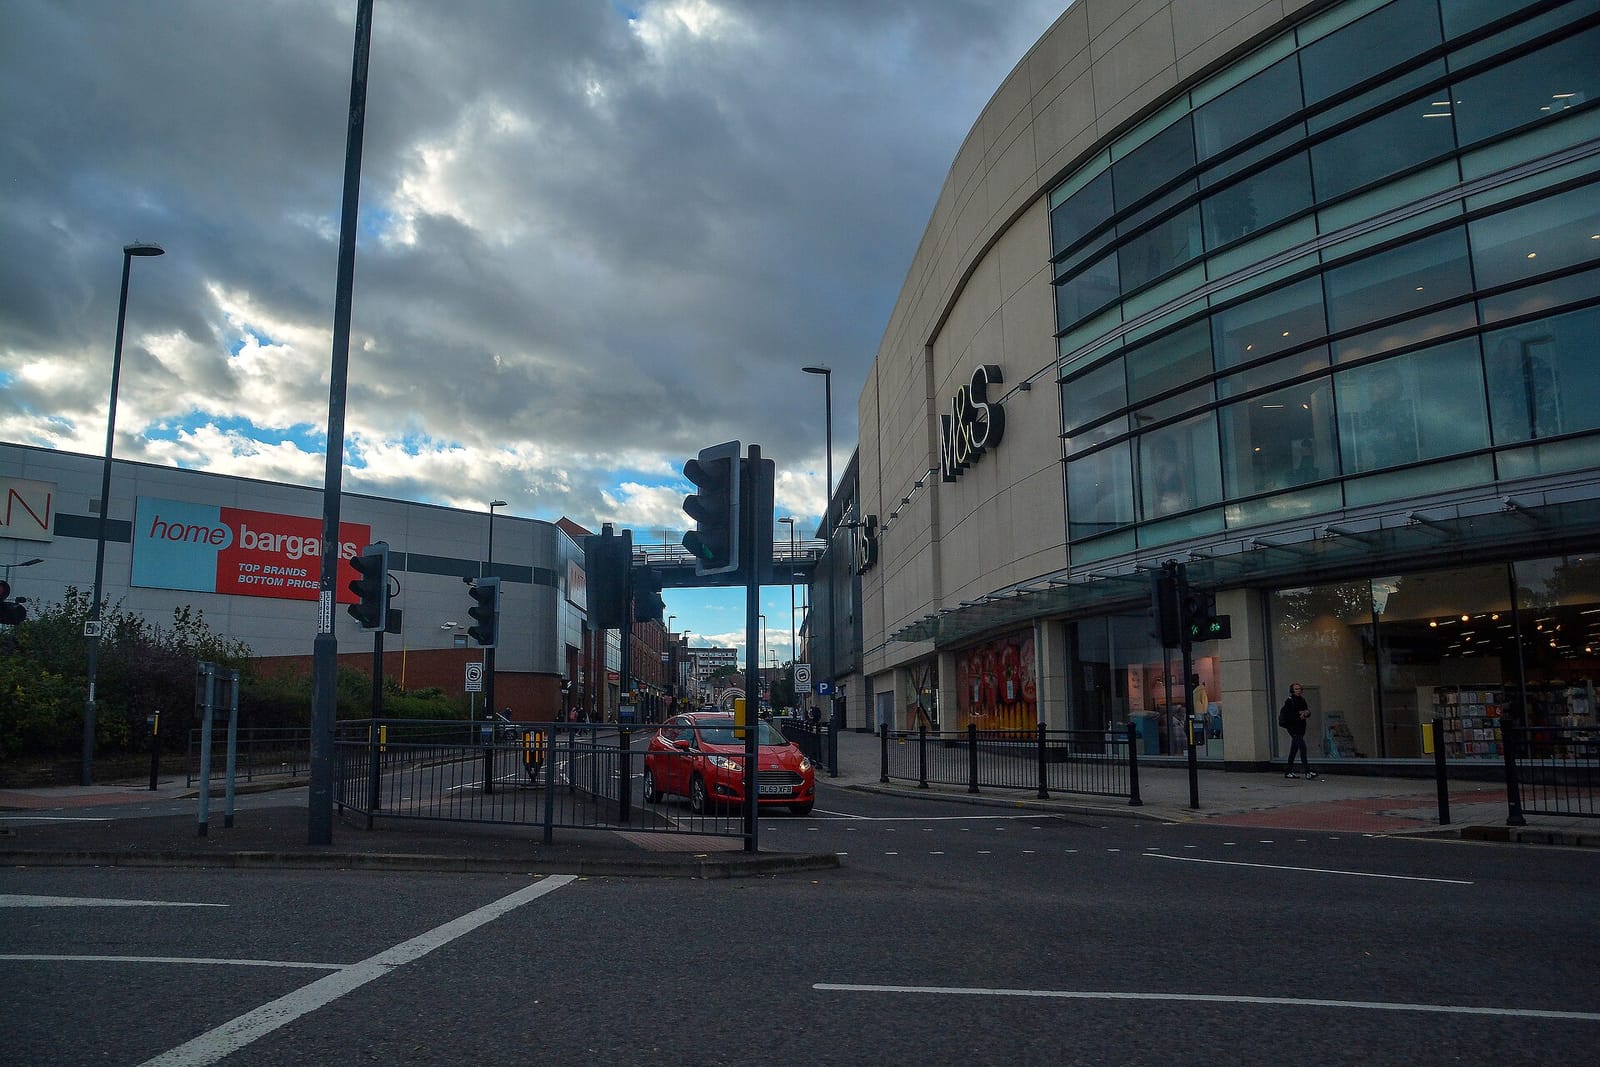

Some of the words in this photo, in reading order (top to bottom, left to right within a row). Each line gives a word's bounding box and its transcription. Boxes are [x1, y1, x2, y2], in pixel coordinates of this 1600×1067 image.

[940, 364, 1003, 482] M&S
[0, 488, 51, 529] N
[150, 515, 225, 545] home
[238, 563, 260, 573] TOP
[264, 565, 307, 577] BRANDS
[238, 575, 283, 586] BOTTOM
[819, 683, 828, 694] P
